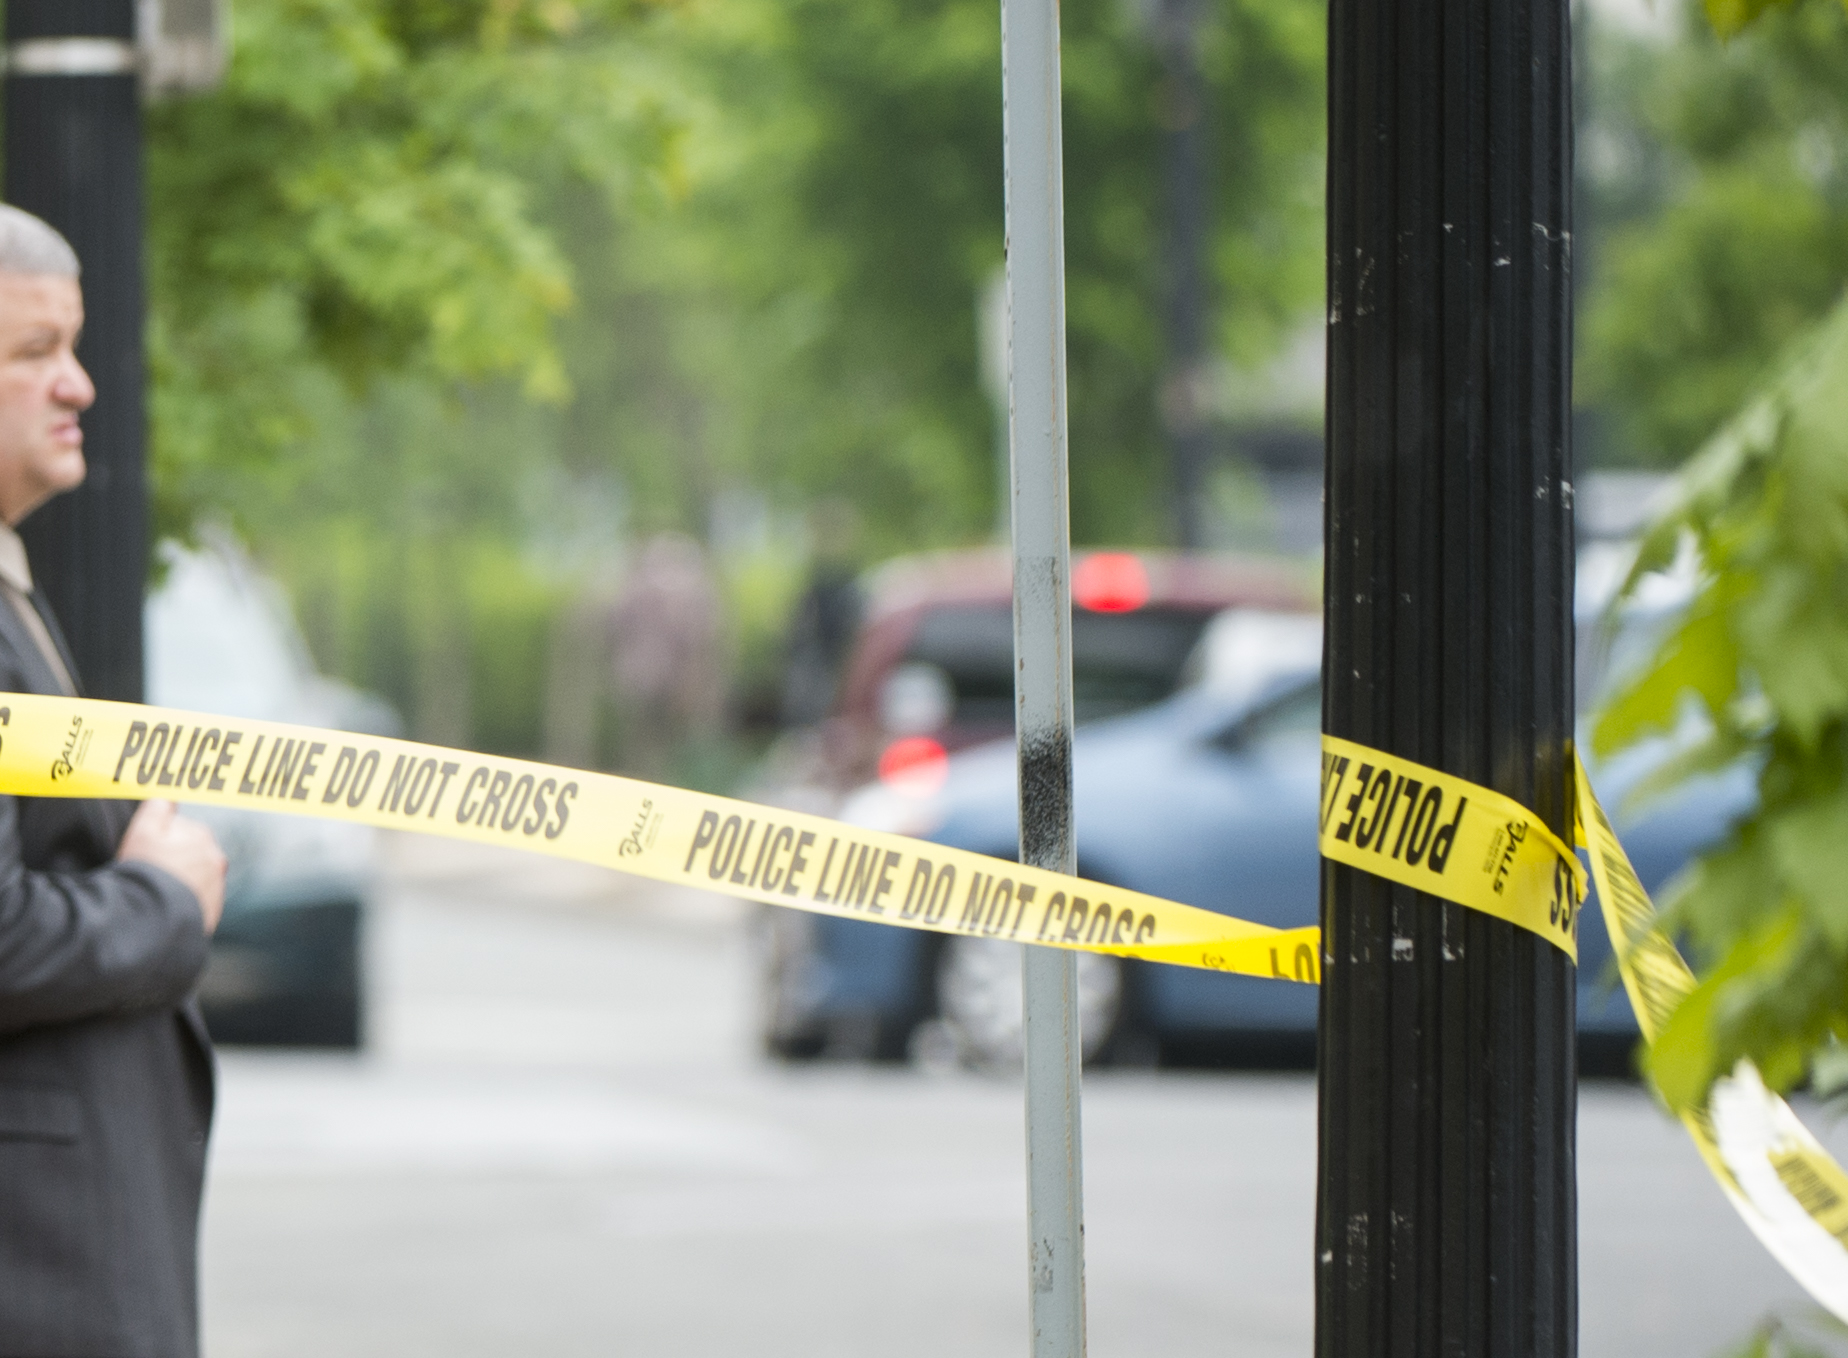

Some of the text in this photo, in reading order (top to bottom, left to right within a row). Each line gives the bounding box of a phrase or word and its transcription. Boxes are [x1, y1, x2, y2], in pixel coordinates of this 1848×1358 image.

[113, 721, 243, 791] POLICE
[238, 735, 327, 801] LINE
[321, 745, 381, 809] DO
[378, 754, 461, 819] NOT
[455, 765, 580, 840] CROSS
[1335, 762, 1469, 875] POLICE
[684, 810, 817, 898] POLICE
[813, 836, 902, 921] LINE
[898, 857, 957, 925] DO
[955, 871, 1037, 942] NOT
